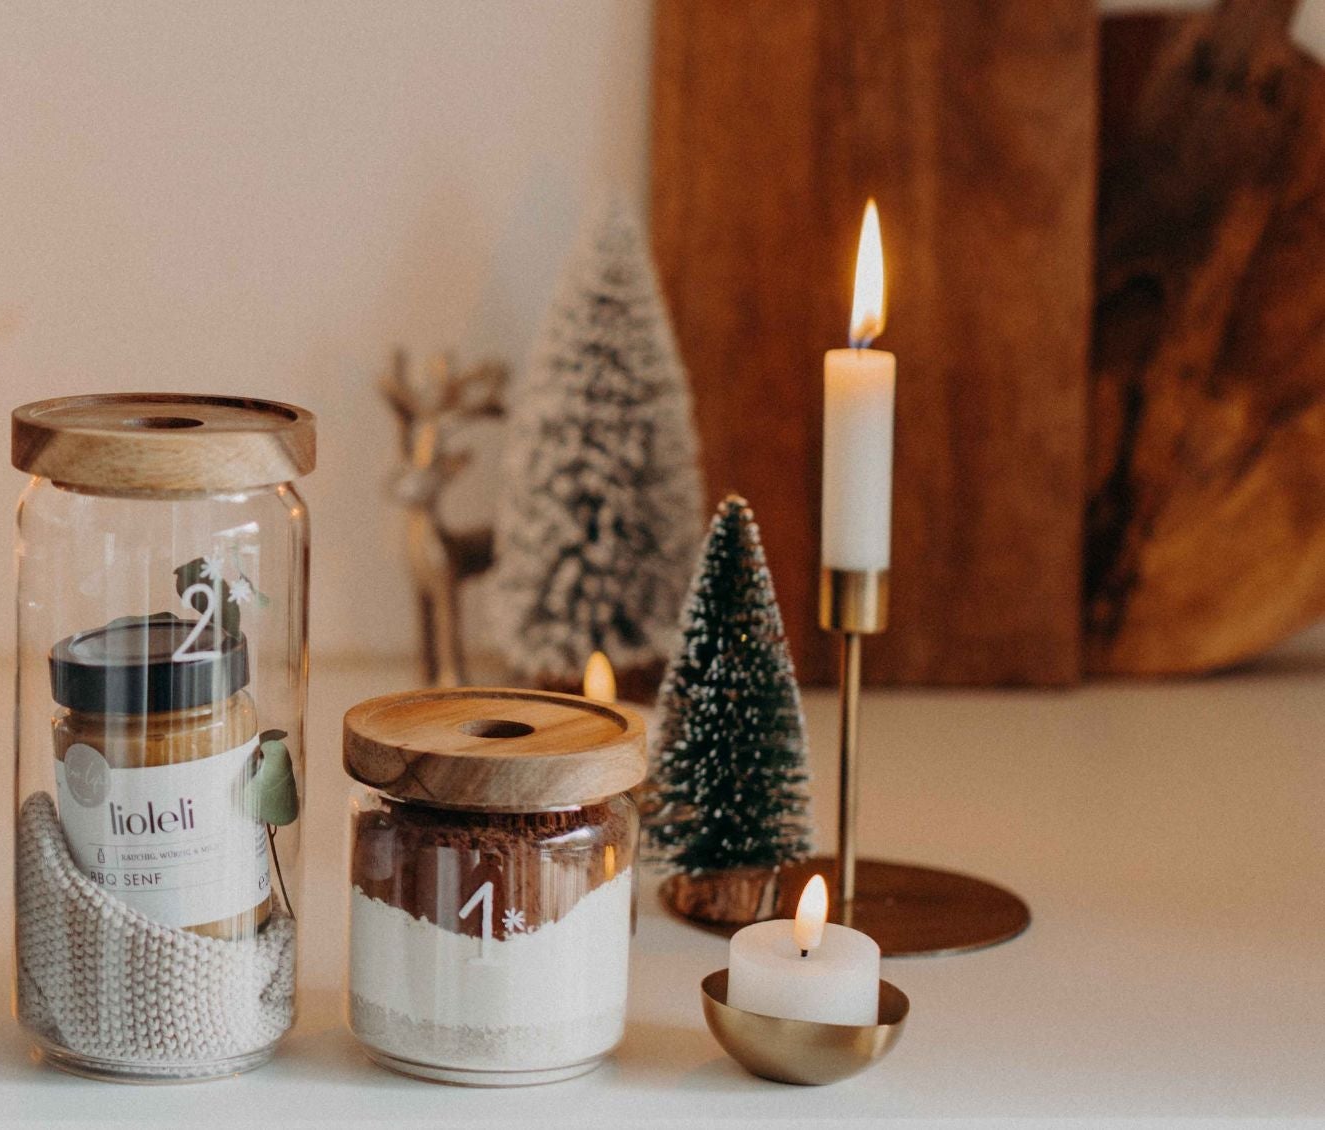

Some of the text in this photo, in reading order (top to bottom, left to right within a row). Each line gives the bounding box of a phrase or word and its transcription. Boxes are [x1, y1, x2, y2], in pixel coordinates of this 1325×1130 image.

[171, 583, 222, 662] 2
[109, 798, 194, 836] lioleli
[90, 870, 163, 886] BBQ SENF
[458, 881, 501, 965] 1
